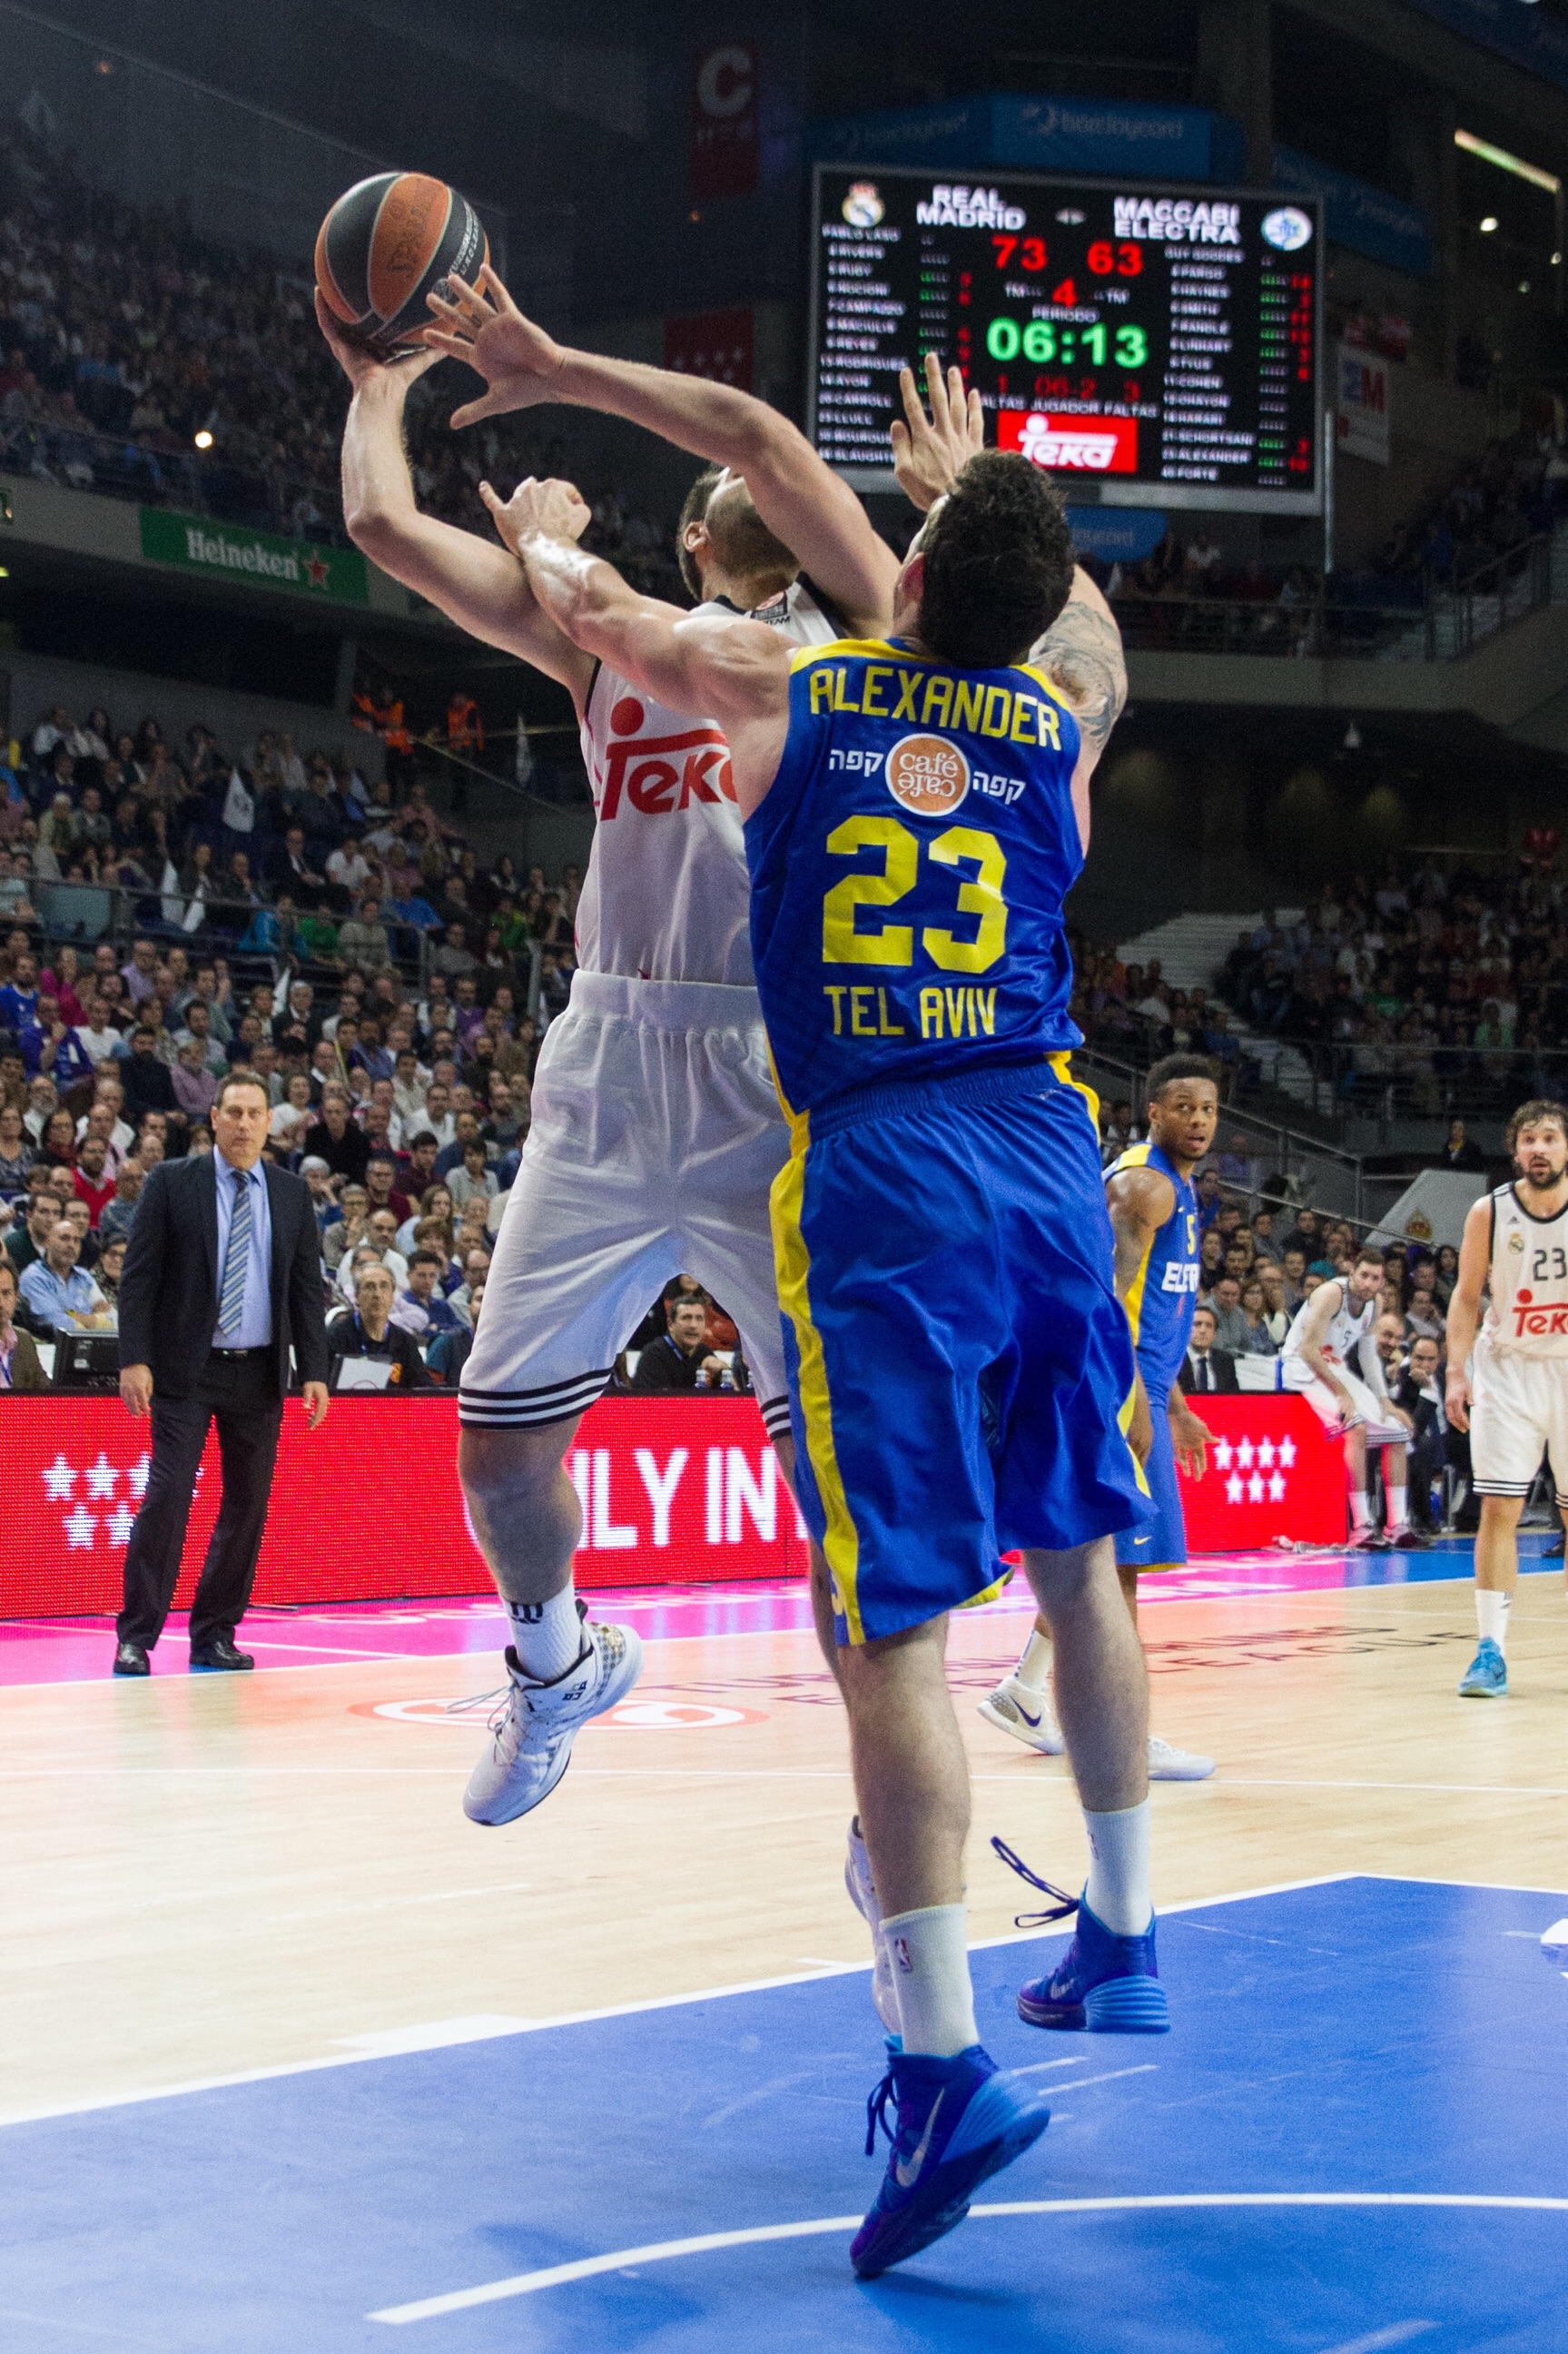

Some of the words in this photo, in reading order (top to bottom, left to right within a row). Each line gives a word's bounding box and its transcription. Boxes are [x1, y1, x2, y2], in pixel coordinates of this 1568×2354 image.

[697, 47, 752, 117] C
[932, 184, 1005, 210] REAL
[1113, 196, 1240, 226] MACCABI
[916, 201, 1027, 230] MADRID
[1114, 219, 1241, 244] ELECTRA
[991, 233, 1048, 272] 73
[1087, 239, 1143, 277] 63
[1051, 276, 1078, 307] 4
[986, 316, 1149, 369] 06:13
[981, 393, 1027, 410] ALTAS
[1017, 414, 1119, 469] Teka
[187, 528, 299, 581] Heineken
[810, 666, 1061, 750] ALEXANDER
[829, 750, 883, 776] קפה
[899, 753, 958, 778] café
[898, 772, 956, 797] café
[972, 772, 1025, 805] קפה
[823, 815, 1009, 974] 23
[823, 986, 904, 1035] TEL
[920, 987, 997, 1038] AVIV
[1533, 1248, 1567, 1281] 23
[1512, 1289, 1568, 1337] Tek
[571, 1448, 688, 1548] ILY
[706, 1446, 776, 1543] IN
